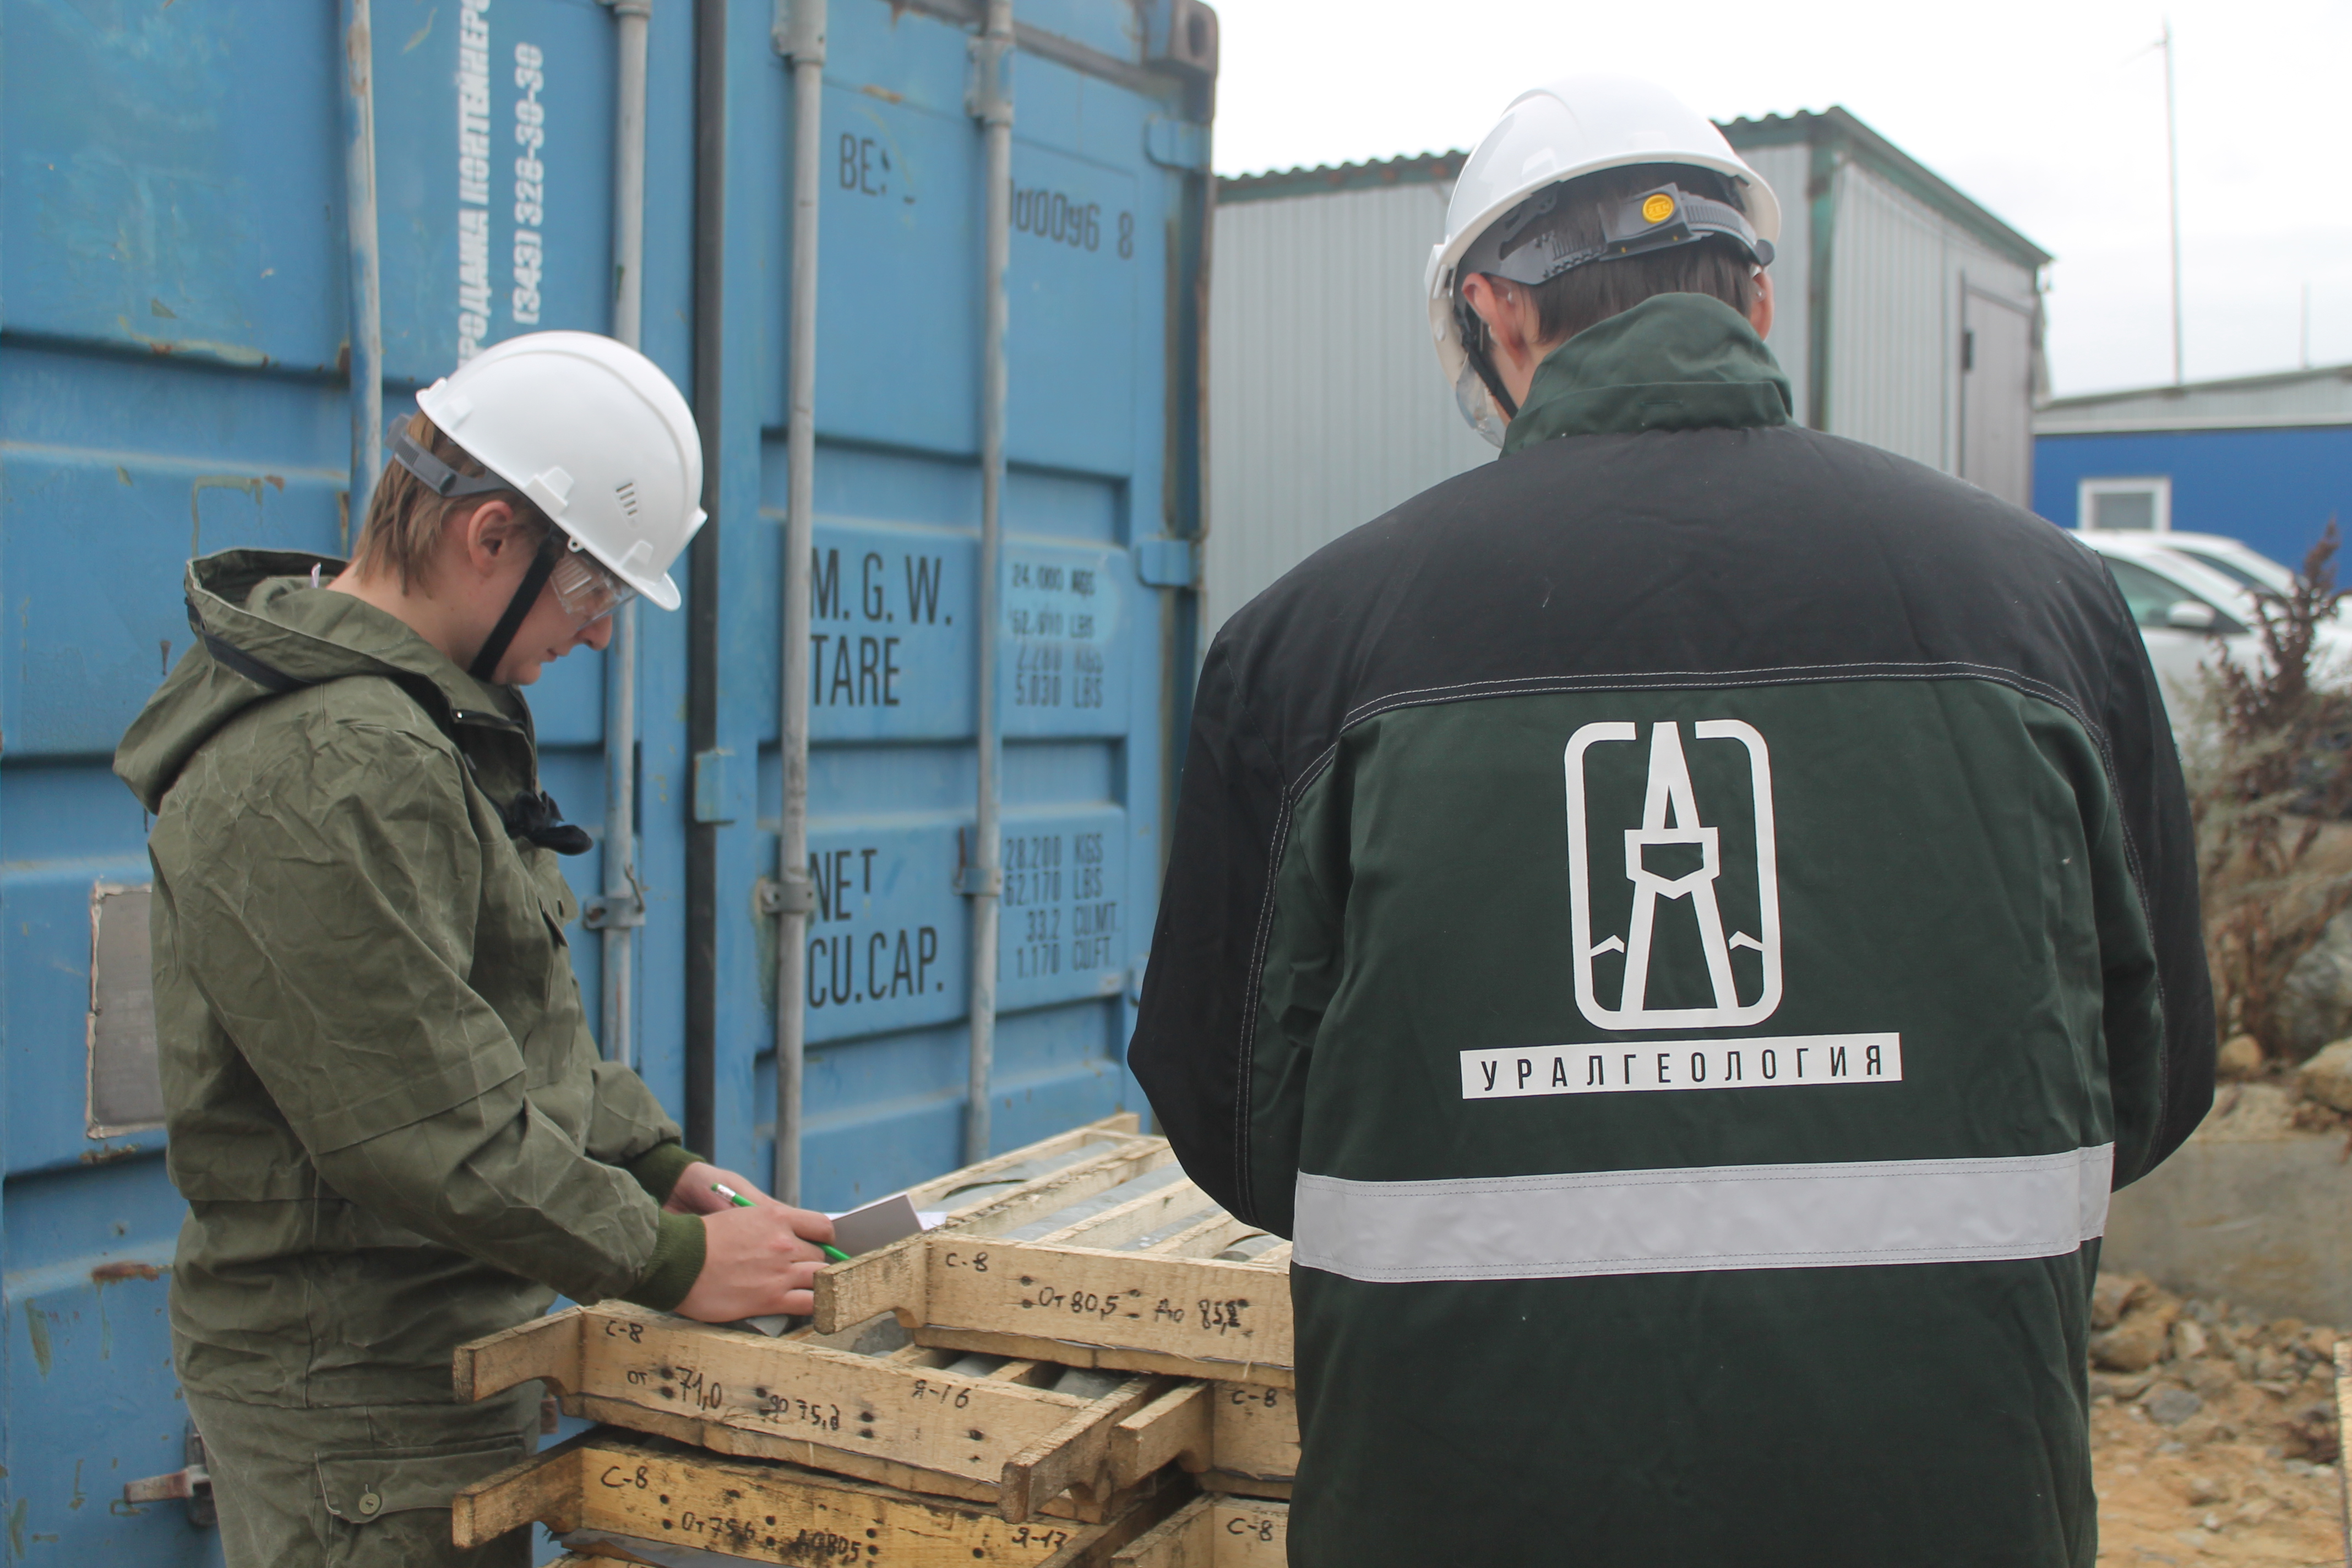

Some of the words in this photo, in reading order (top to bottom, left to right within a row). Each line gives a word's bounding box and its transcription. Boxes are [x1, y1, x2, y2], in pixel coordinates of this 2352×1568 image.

[515, 42, 545, 226] 328-30-30
[1009, 177, 1101, 252] 00096
[1118, 210, 1134, 260] 8
[811, 634, 901, 707] TARE
[1074, 676, 1103, 708] LBS
[809, 848, 878, 923] NET
[1073, 867, 1103, 900] LBS
[808, 927, 943, 1009] CU.CAP.
[1481, 1045, 1882, 1092] УРАЛГЕОЛОГИЯ
